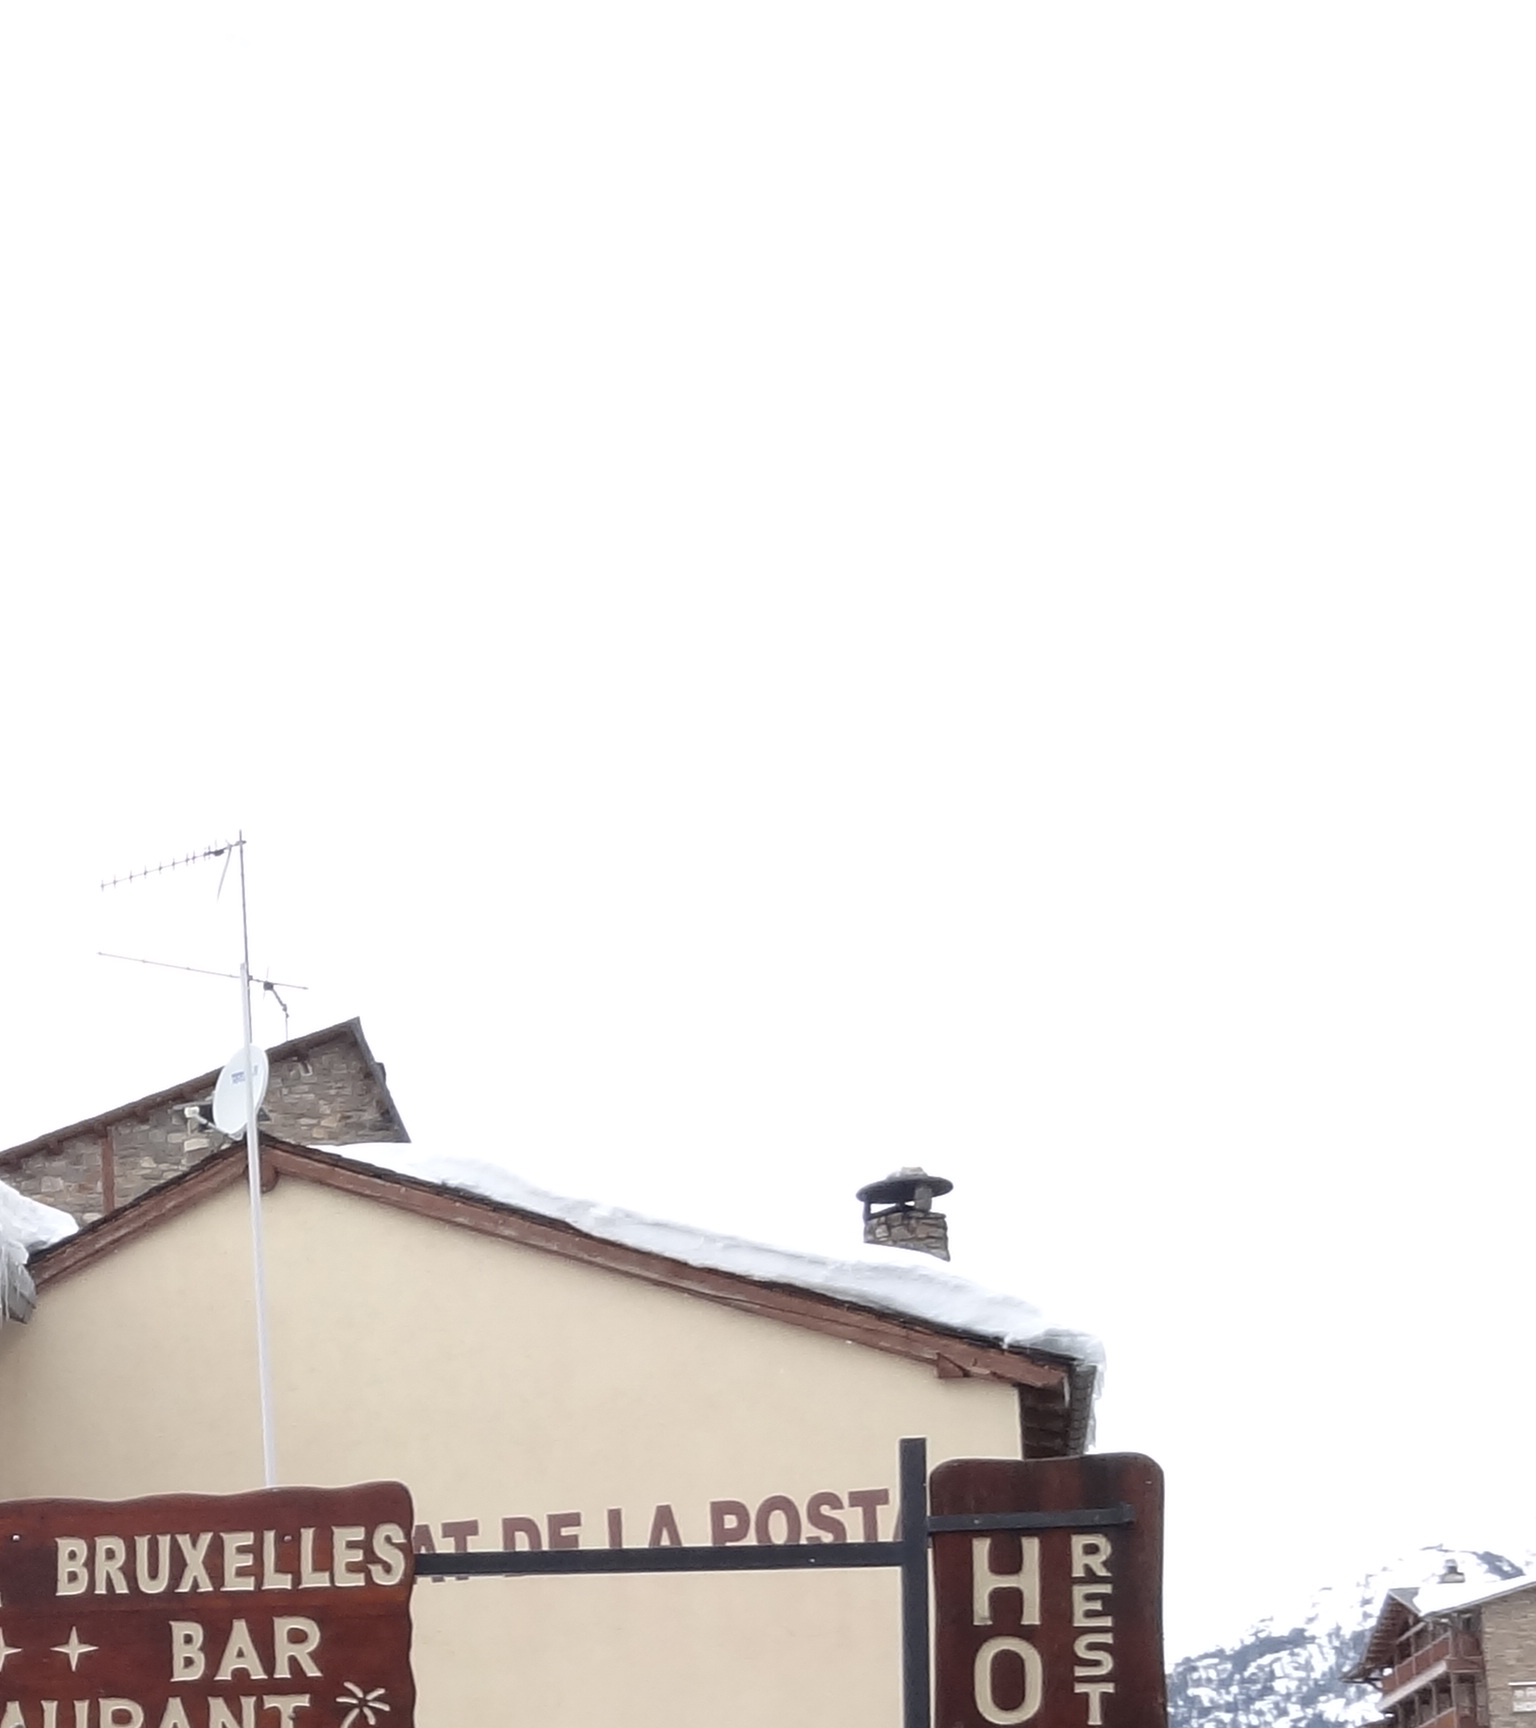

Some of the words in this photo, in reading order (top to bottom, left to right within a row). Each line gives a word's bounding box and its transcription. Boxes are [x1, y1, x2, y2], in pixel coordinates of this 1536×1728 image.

[709, 1488, 904, 1545] POST
[55, 1522, 407, 1597] BRUXELLES
[169, 1616, 325, 1683] BAR
